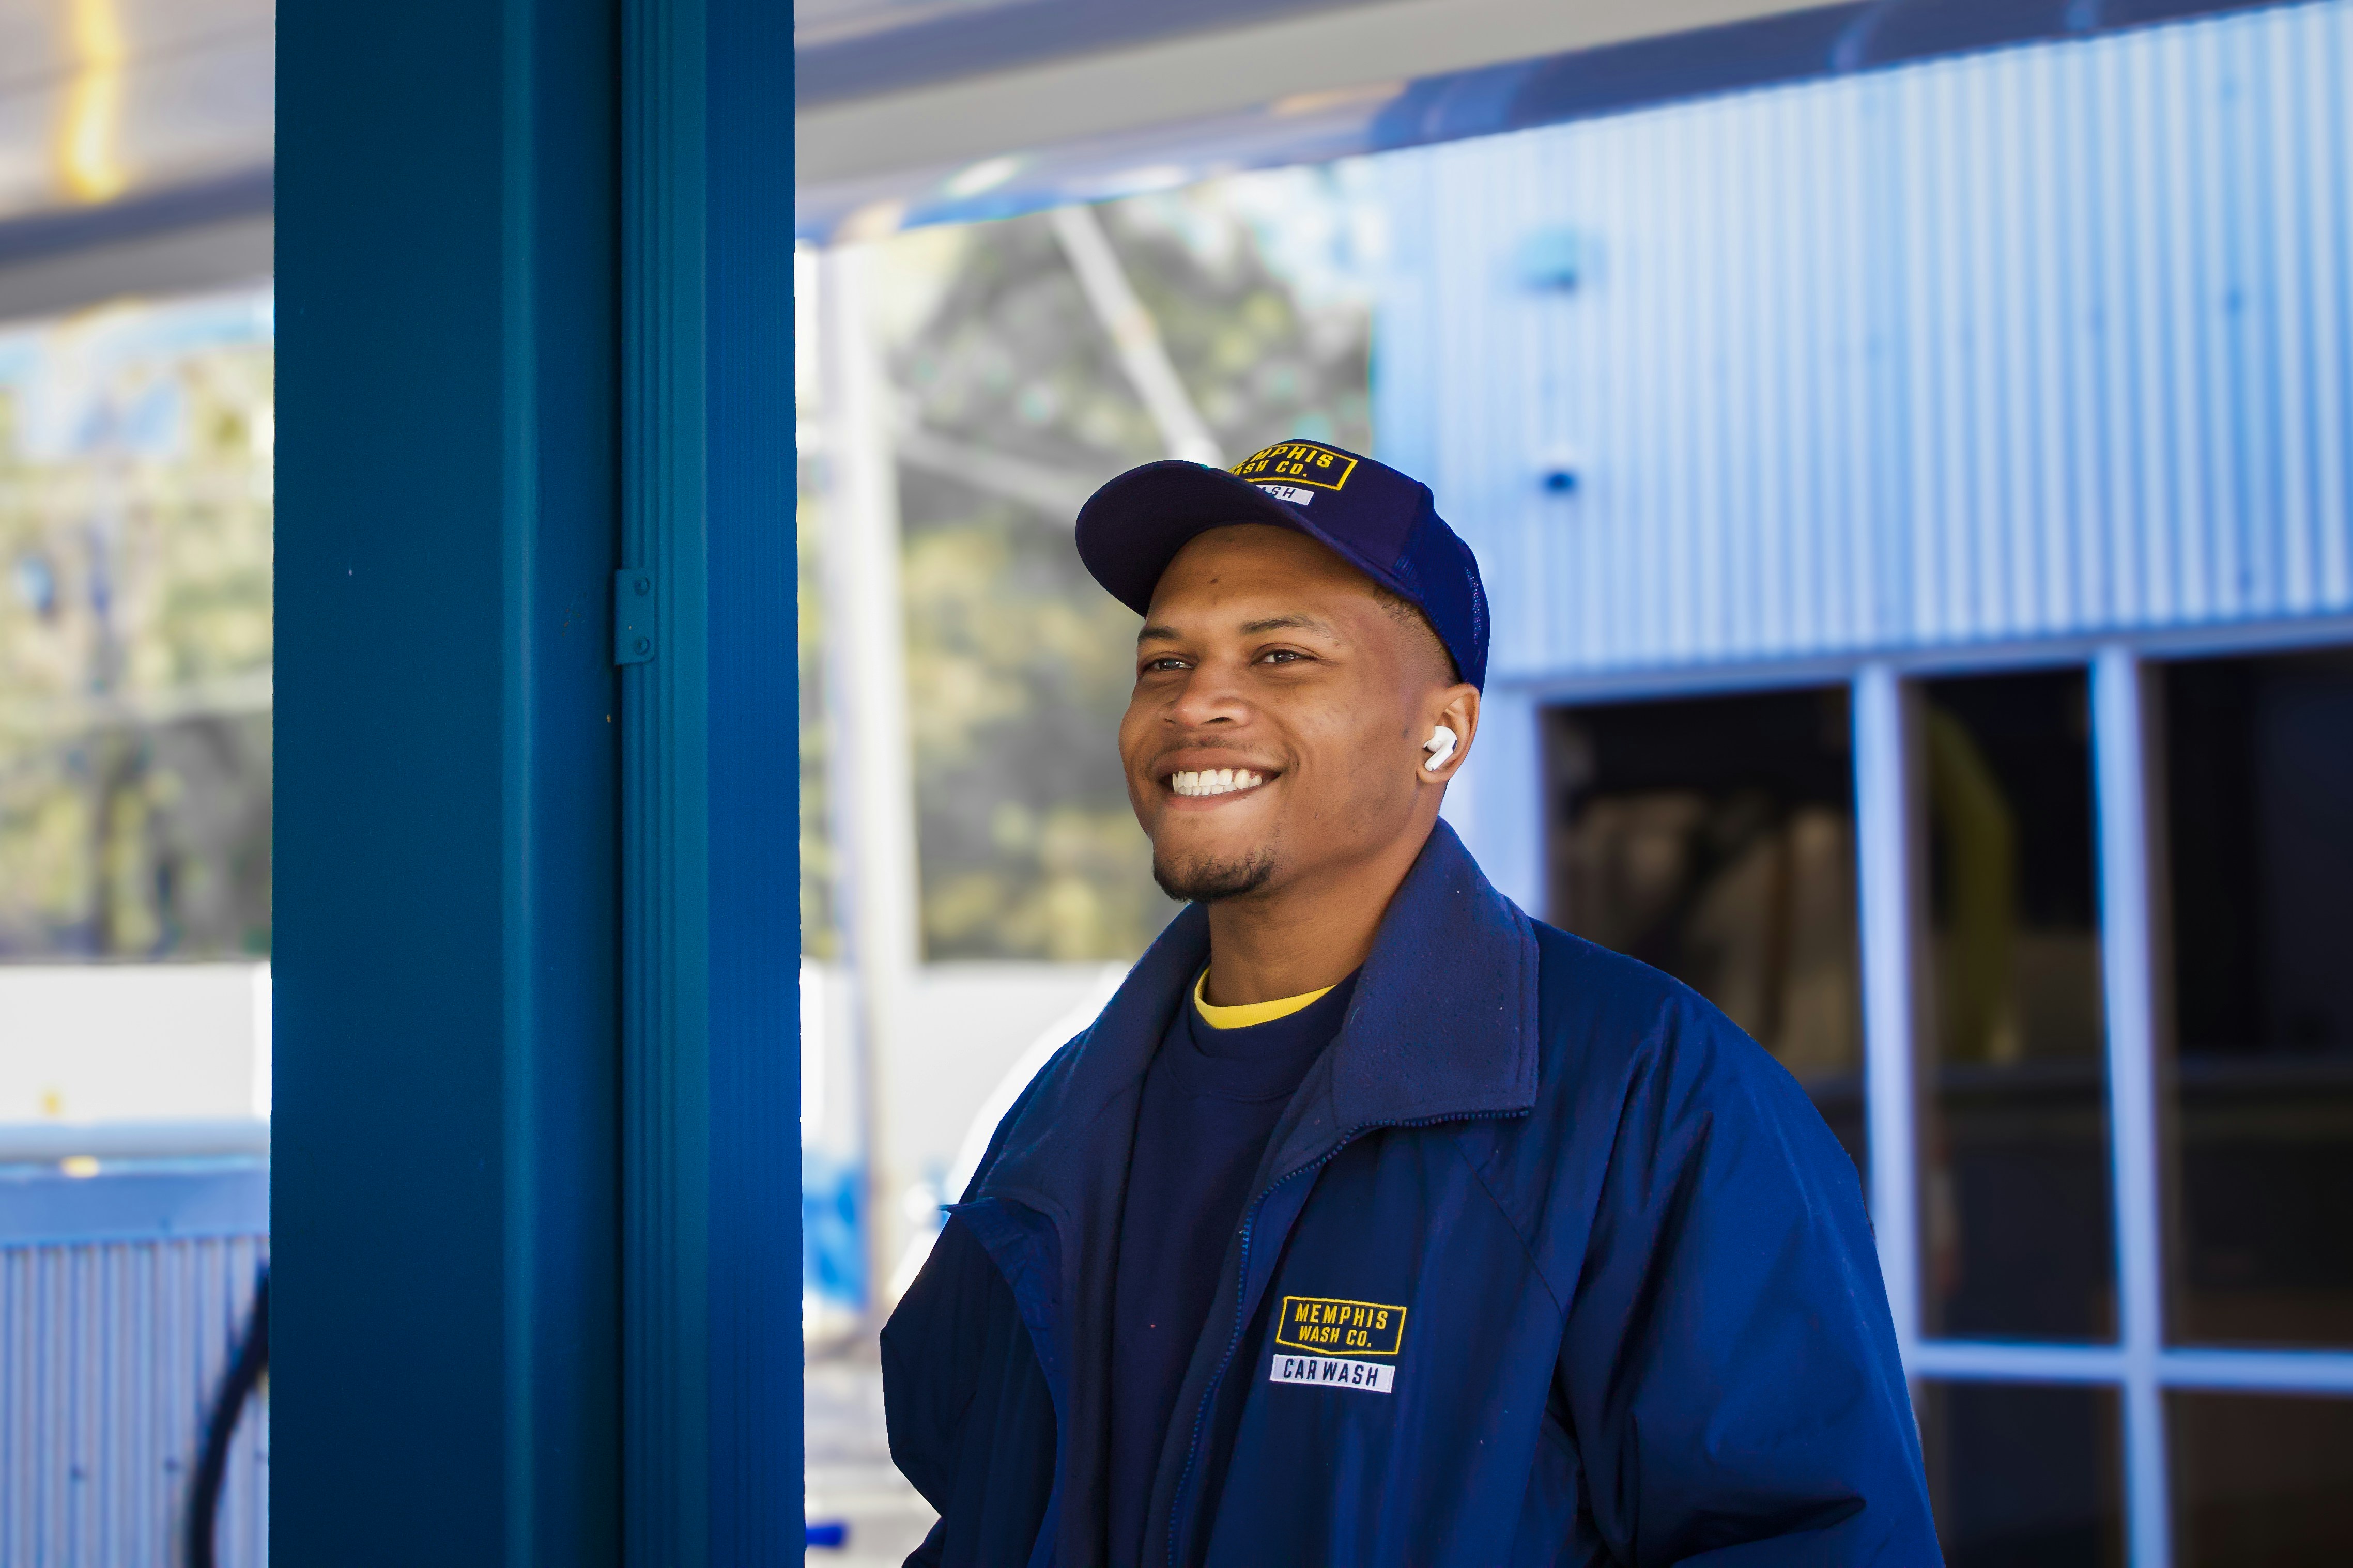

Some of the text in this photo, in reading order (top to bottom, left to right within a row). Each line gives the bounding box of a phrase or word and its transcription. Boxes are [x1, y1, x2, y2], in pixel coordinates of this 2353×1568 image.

[1241, 446, 1334, 468] MPHIS
[1275, 461, 1308, 477] CO.
[1295, 1303, 1388, 1329] MEMPHIS
[1299, 1325, 1371, 1347] WASH CO.
[1283, 1358, 1378, 1387] CAR WASH
